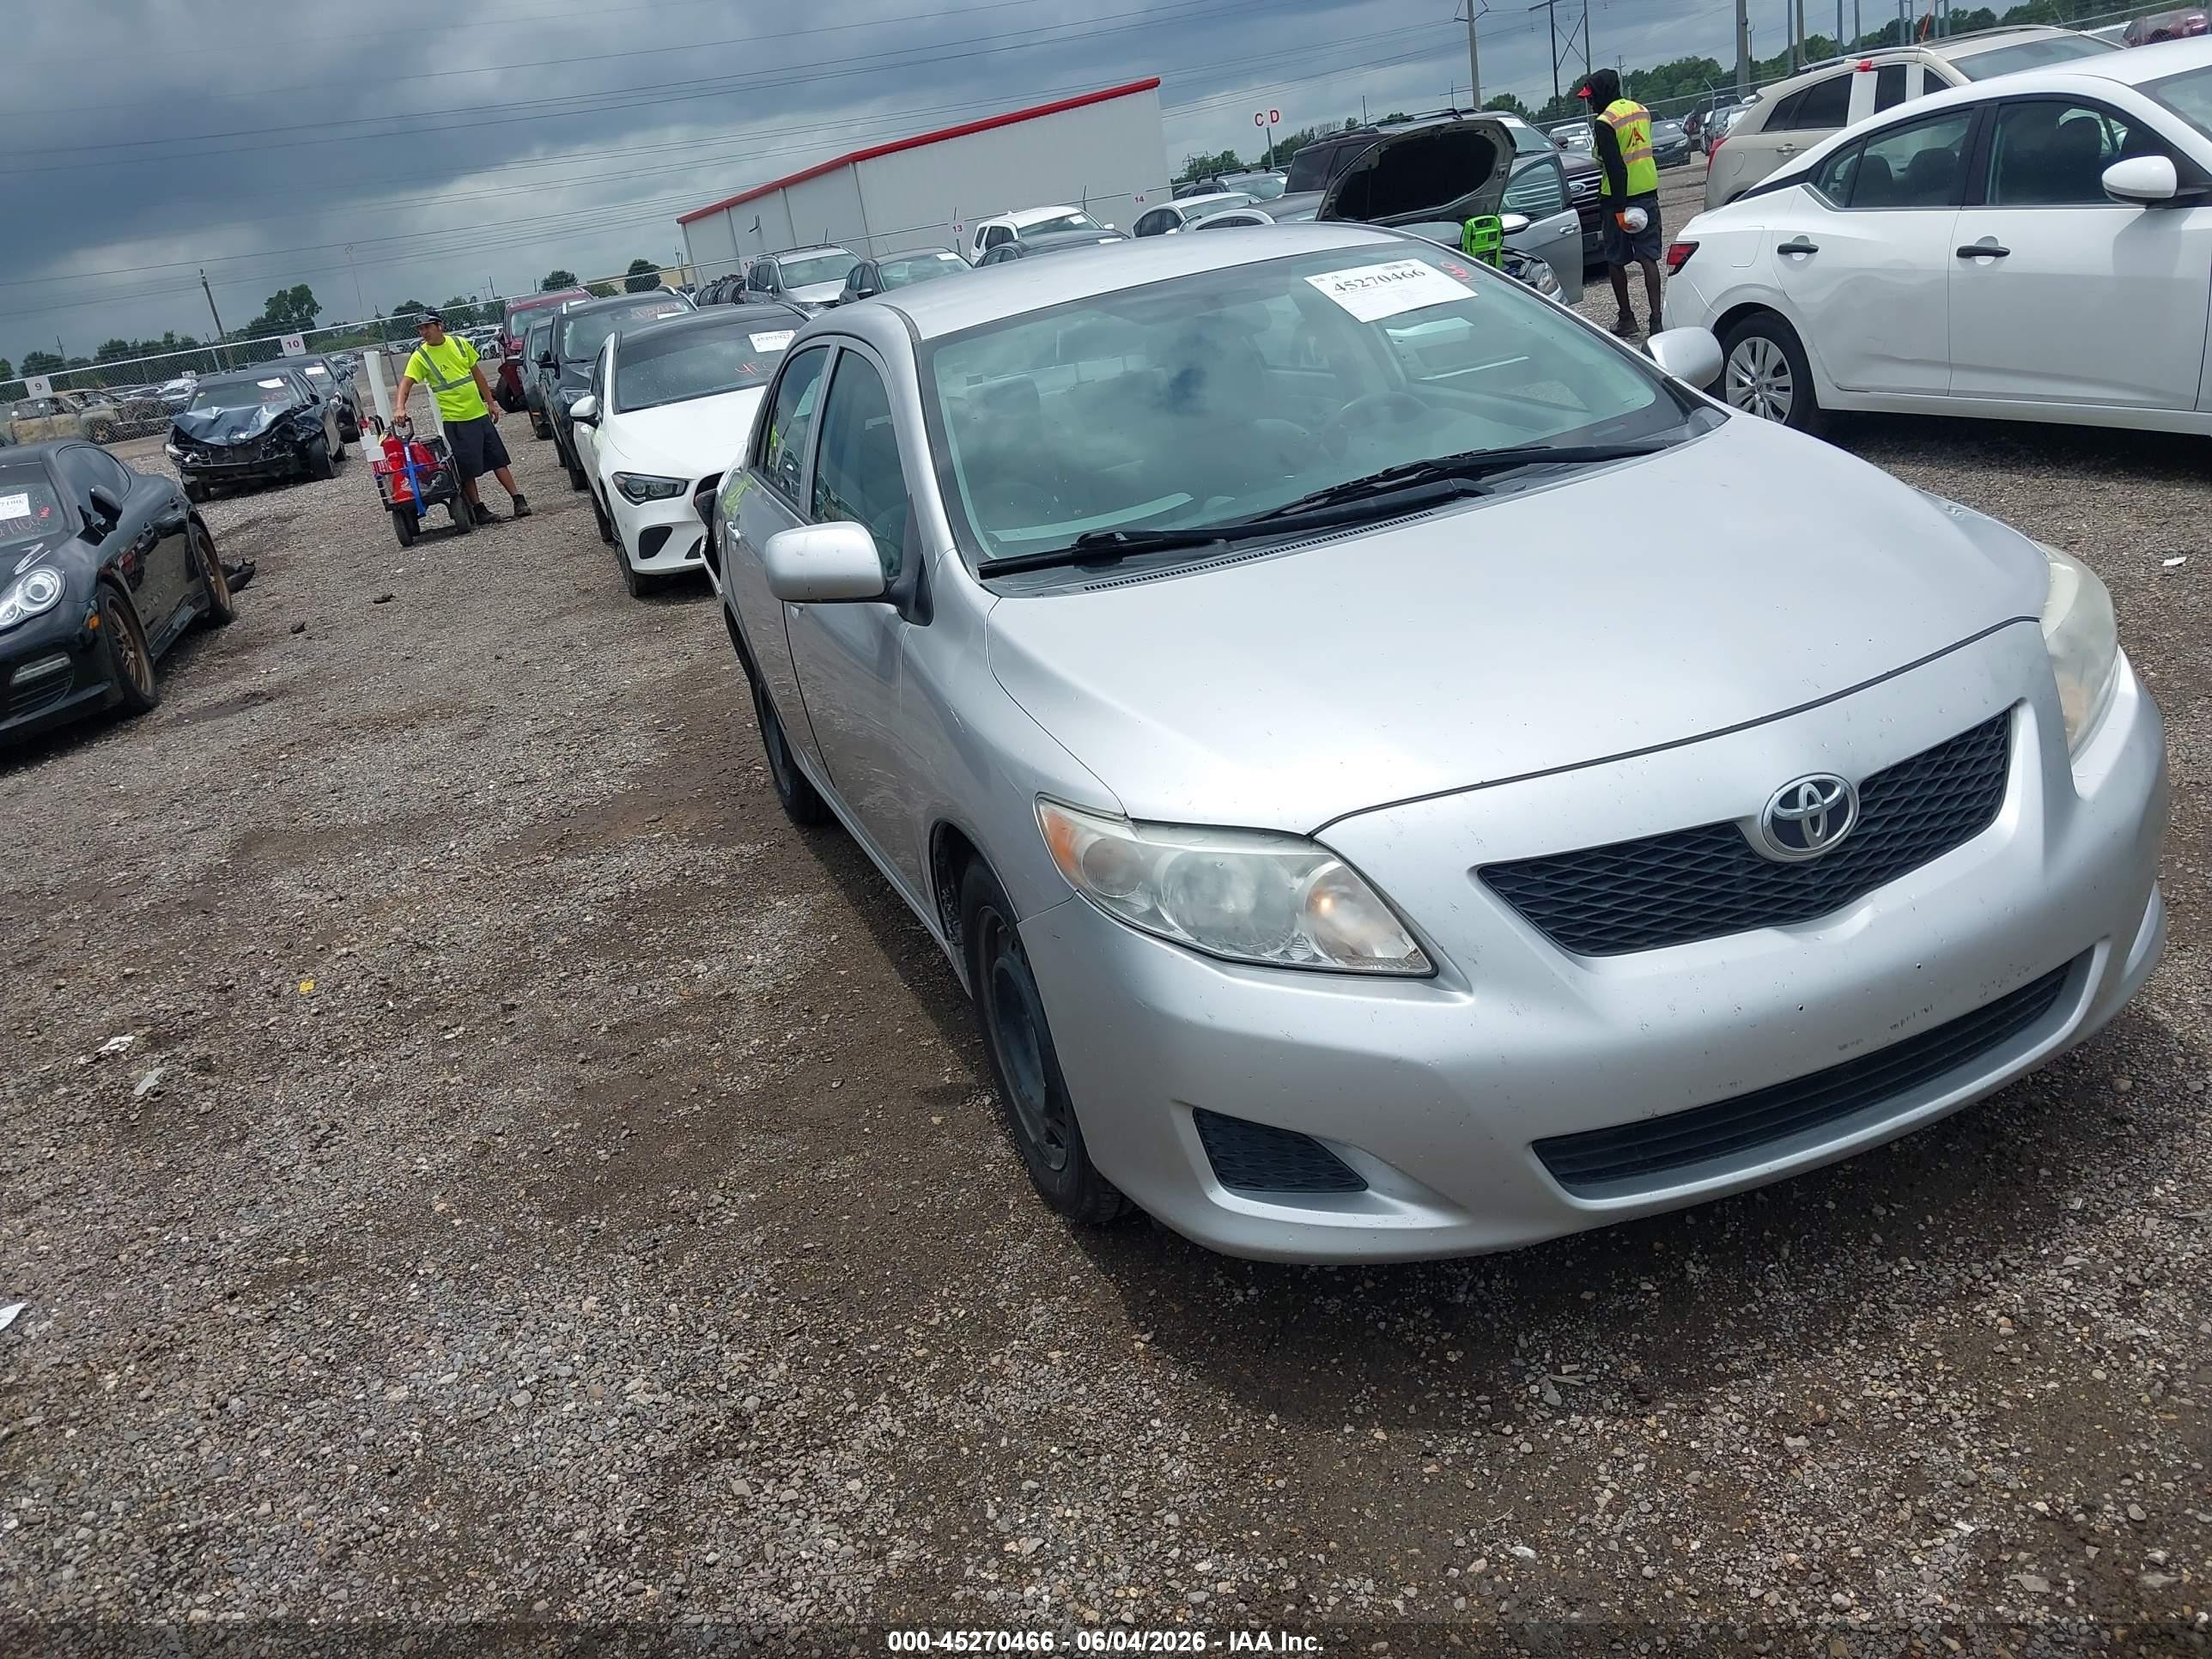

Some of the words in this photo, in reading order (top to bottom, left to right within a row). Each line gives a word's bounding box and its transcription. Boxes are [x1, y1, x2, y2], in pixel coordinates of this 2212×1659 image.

[1255, 112, 1264, 126] C
[1270, 110, 1279, 123] D
[952, 224, 963, 233] 13
[1334, 268, 1426, 292] 45270466
[286, 340, 300, 349] 10
[34, 382, 42, 391] 9
